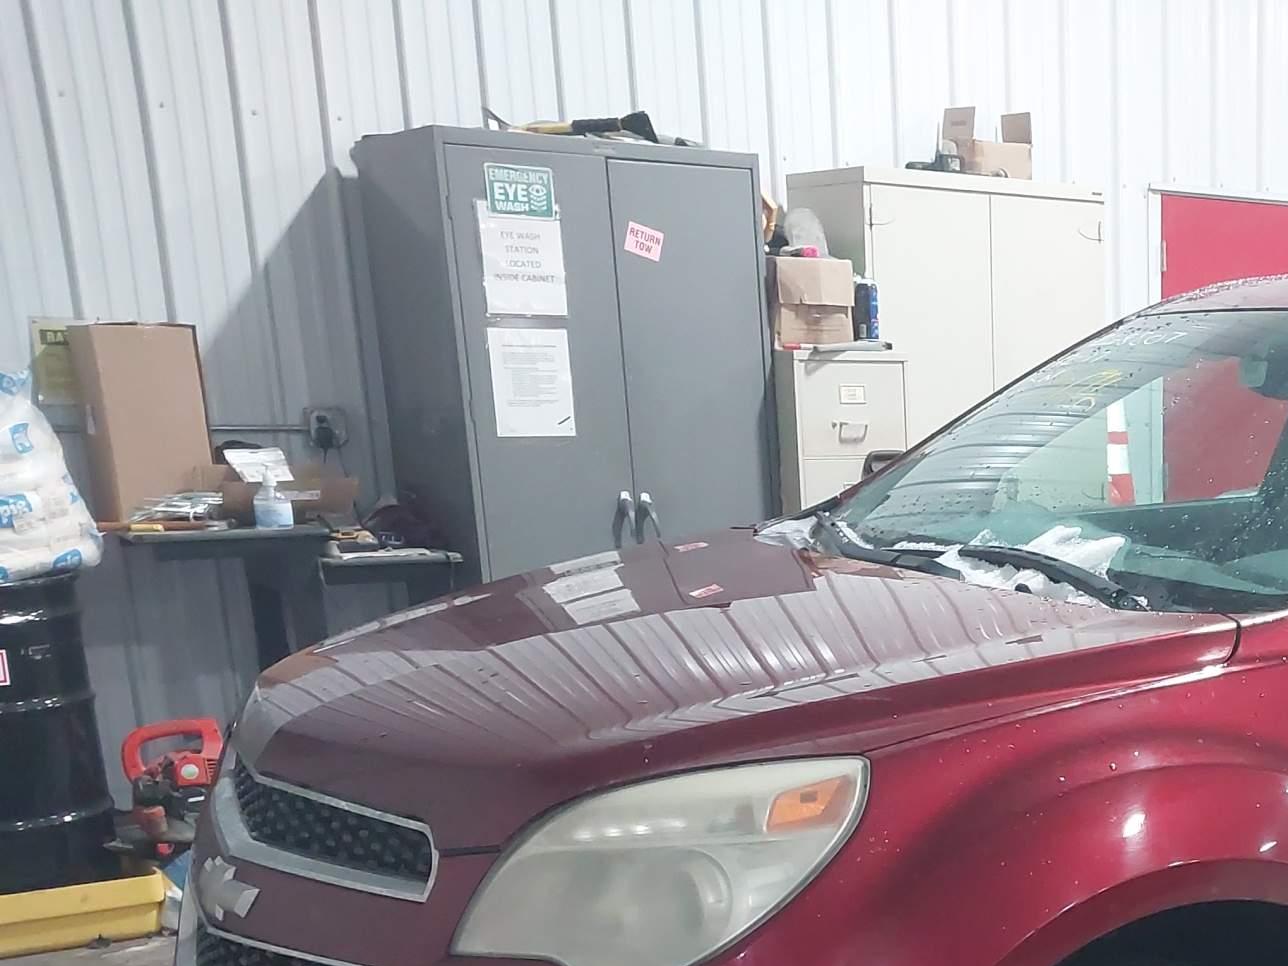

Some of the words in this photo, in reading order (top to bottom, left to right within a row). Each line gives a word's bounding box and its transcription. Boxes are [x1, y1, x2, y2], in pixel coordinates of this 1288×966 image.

[488, 167, 548, 185] EMERGENCY
[493, 182, 528, 202] EYE
[494, 201, 529, 212] WASH
[515, 232, 541, 241] WASH
[629, 227, 661, 246] RETURN
[505, 245, 539, 254] STATION
[635, 240, 653, 254] TOW
[505, 260, 541, 269] LOCATED
[521, 275, 554, 283] CABINET
